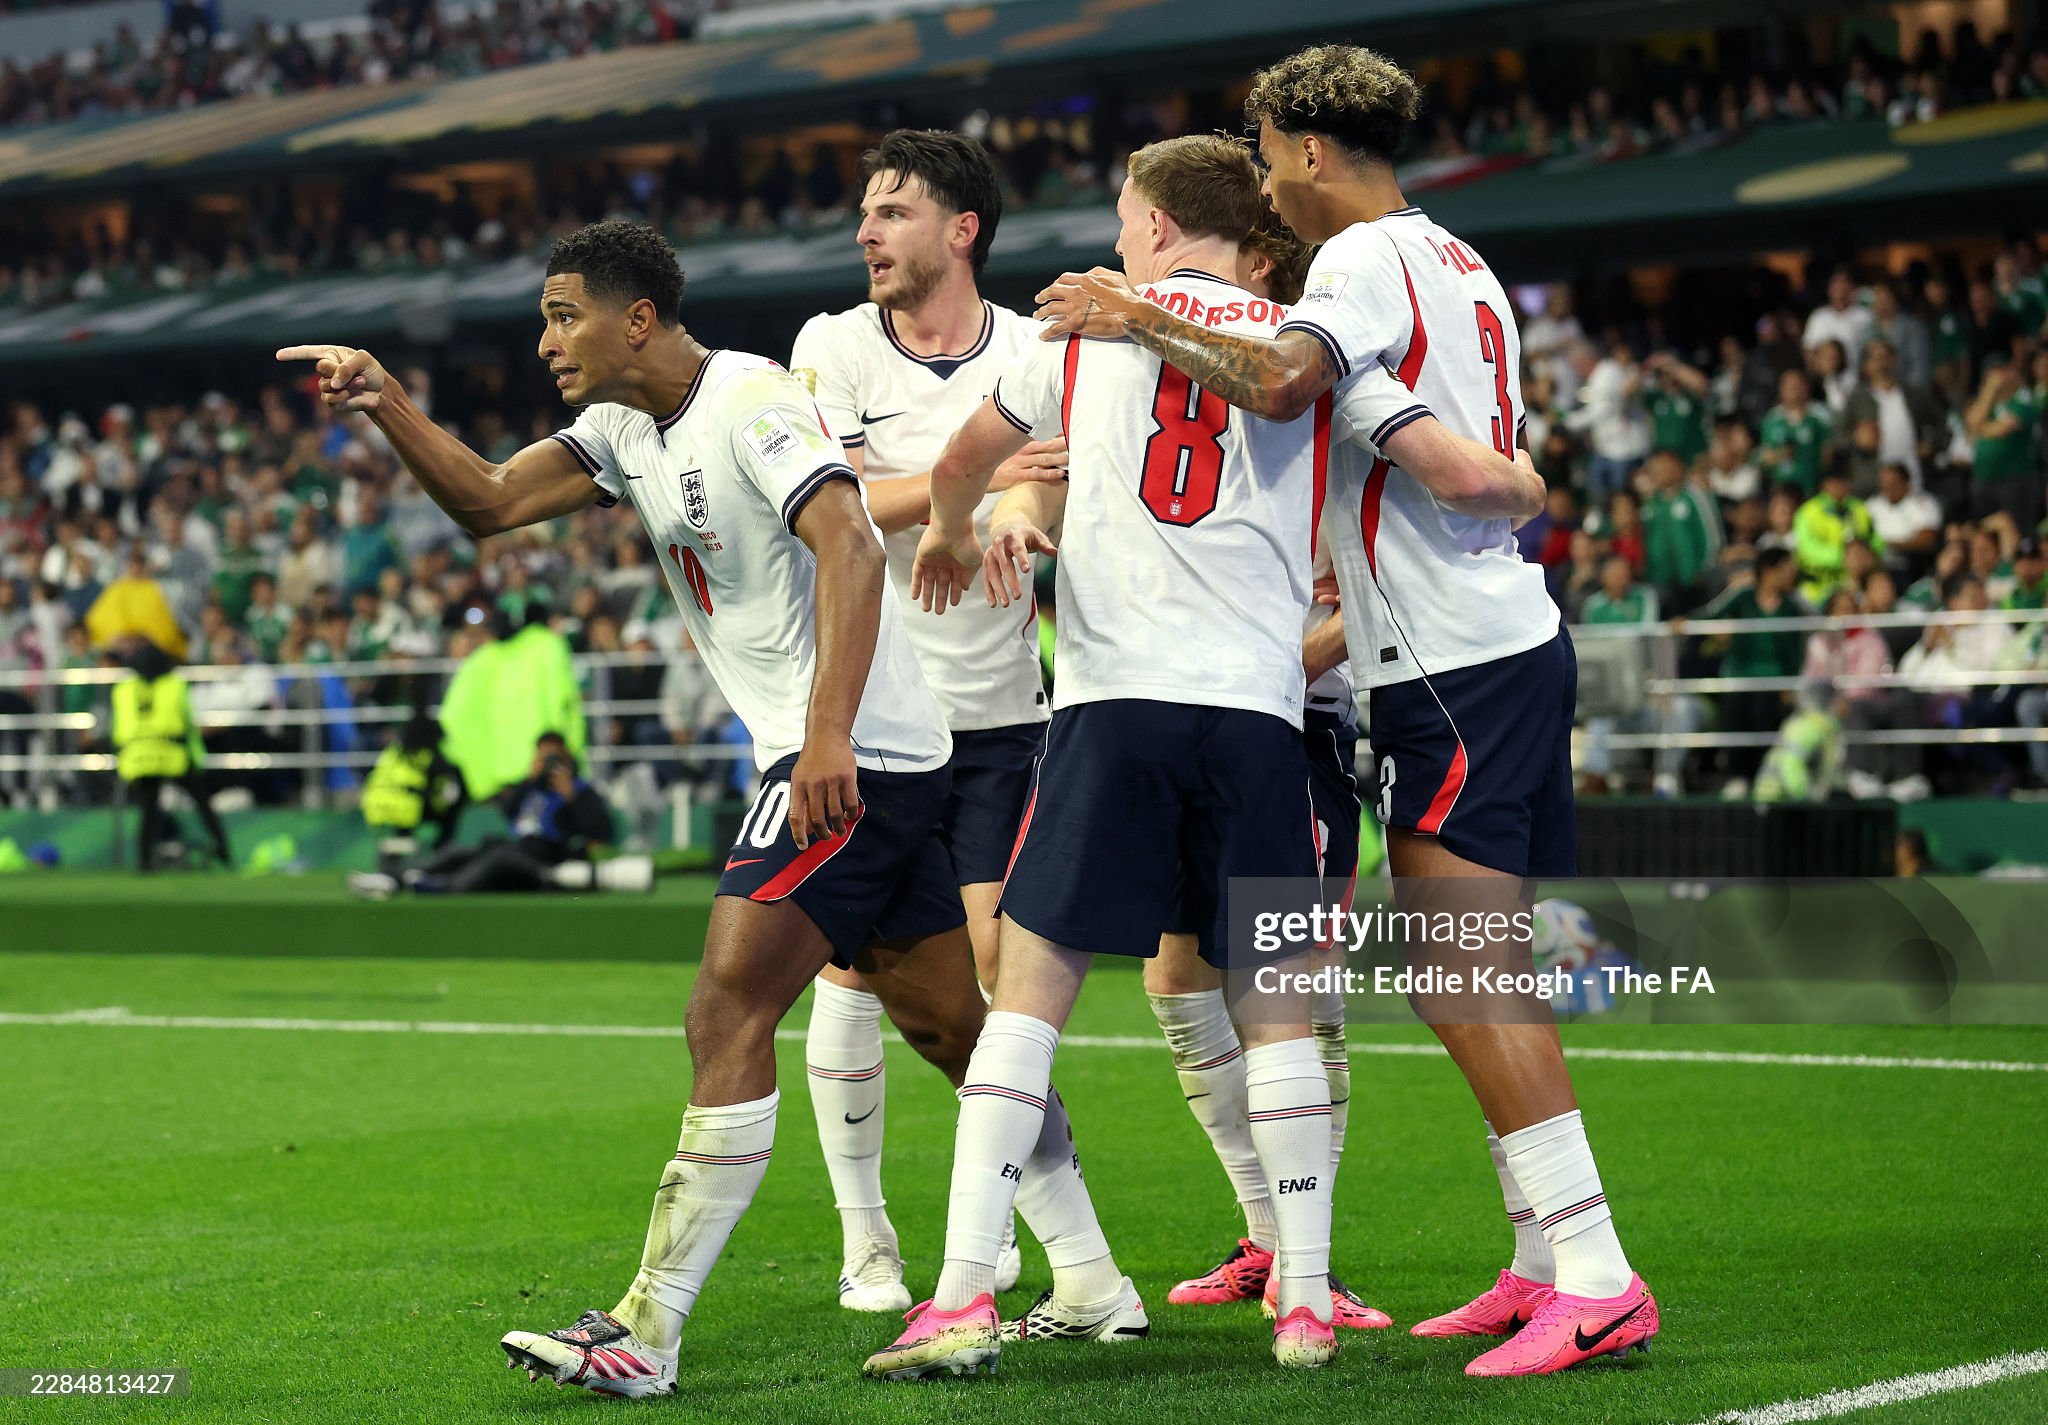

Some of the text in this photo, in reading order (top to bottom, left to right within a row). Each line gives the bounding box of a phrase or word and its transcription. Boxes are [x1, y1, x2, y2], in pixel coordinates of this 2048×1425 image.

[1142, 287, 1286, 327] NDERSON
[1475, 301, 1515, 462] 3
[761, 433, 790, 457] EDUCATION
[1139, 360, 1230, 529] 8
[669, 544, 714, 617] 10
[735, 780, 792, 849] 10
[1376, 755, 1397, 825] 3
[1000, 1162, 1023, 1185] EN
[1278, 1176, 1318, 1195] ENG
